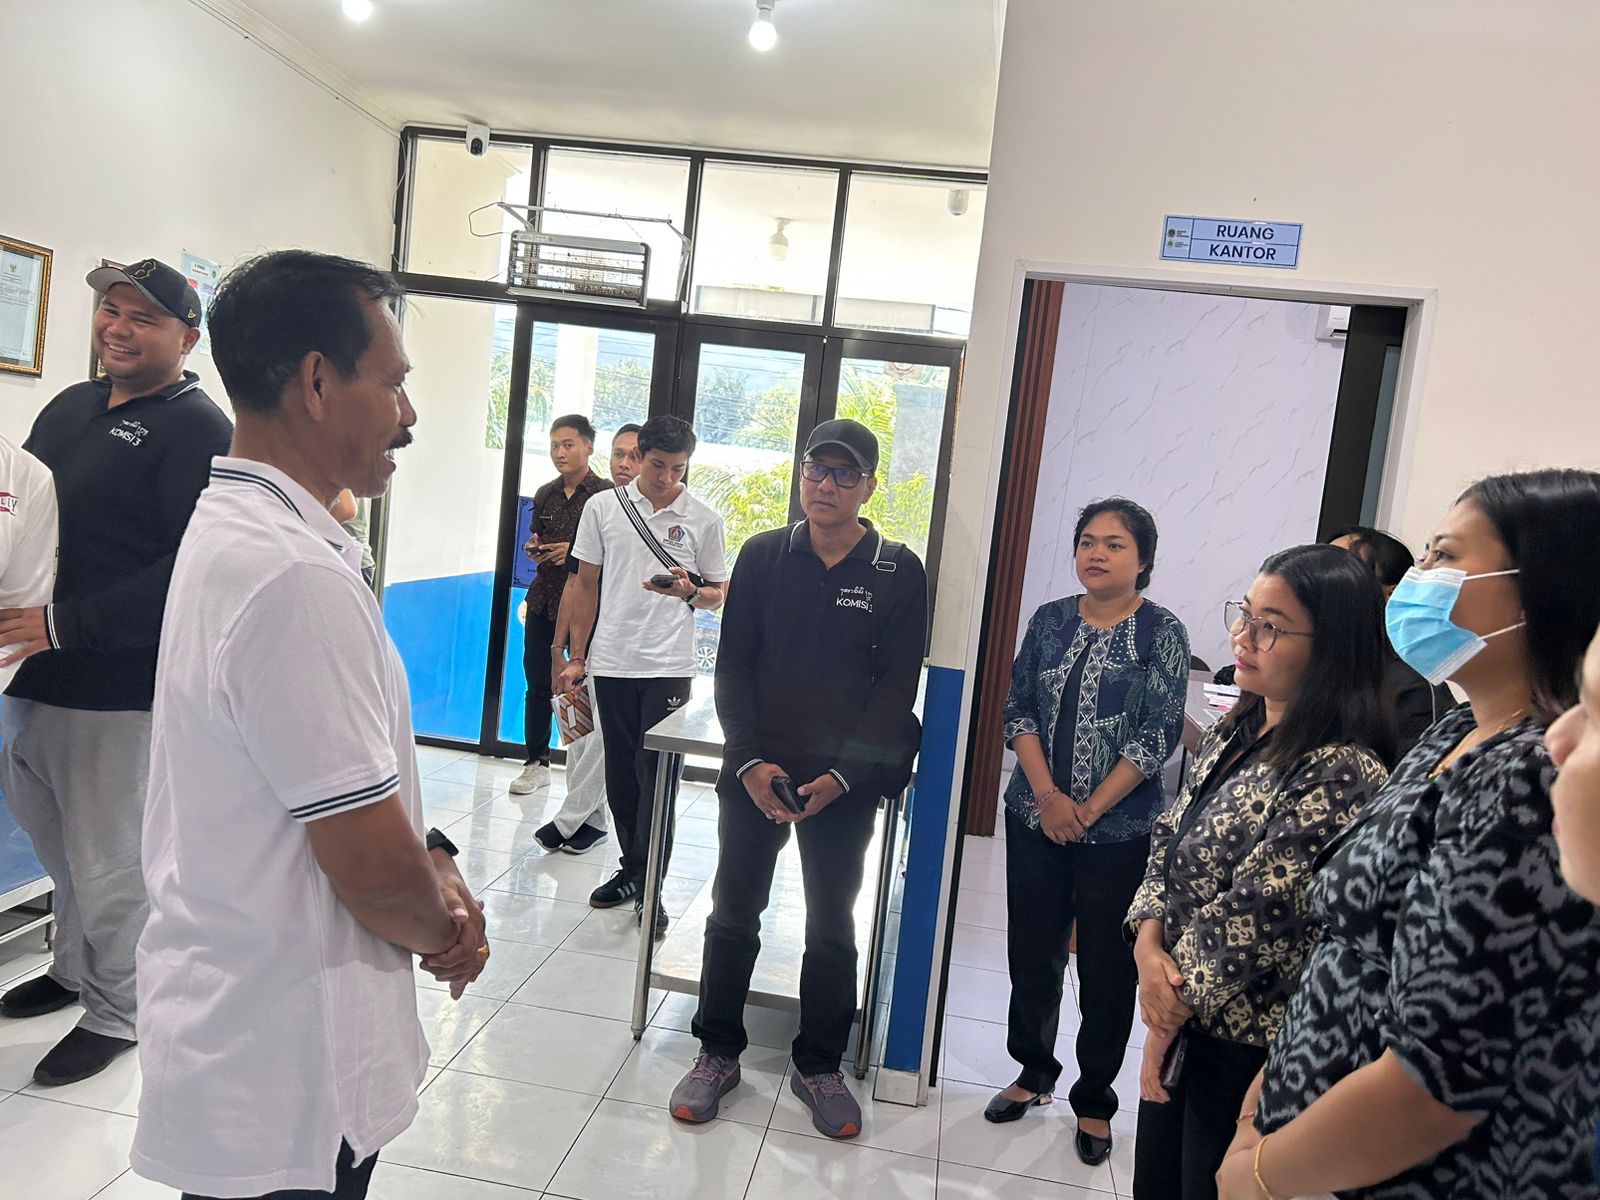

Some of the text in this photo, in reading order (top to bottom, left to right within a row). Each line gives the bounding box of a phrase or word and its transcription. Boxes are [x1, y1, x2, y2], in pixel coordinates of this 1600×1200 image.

[1216, 224, 1275, 240] RUANG
[1209, 243, 1277, 261] KANTOR
[132, 437, 142, 446] 3
[836, 597, 869, 611] KOMISI
